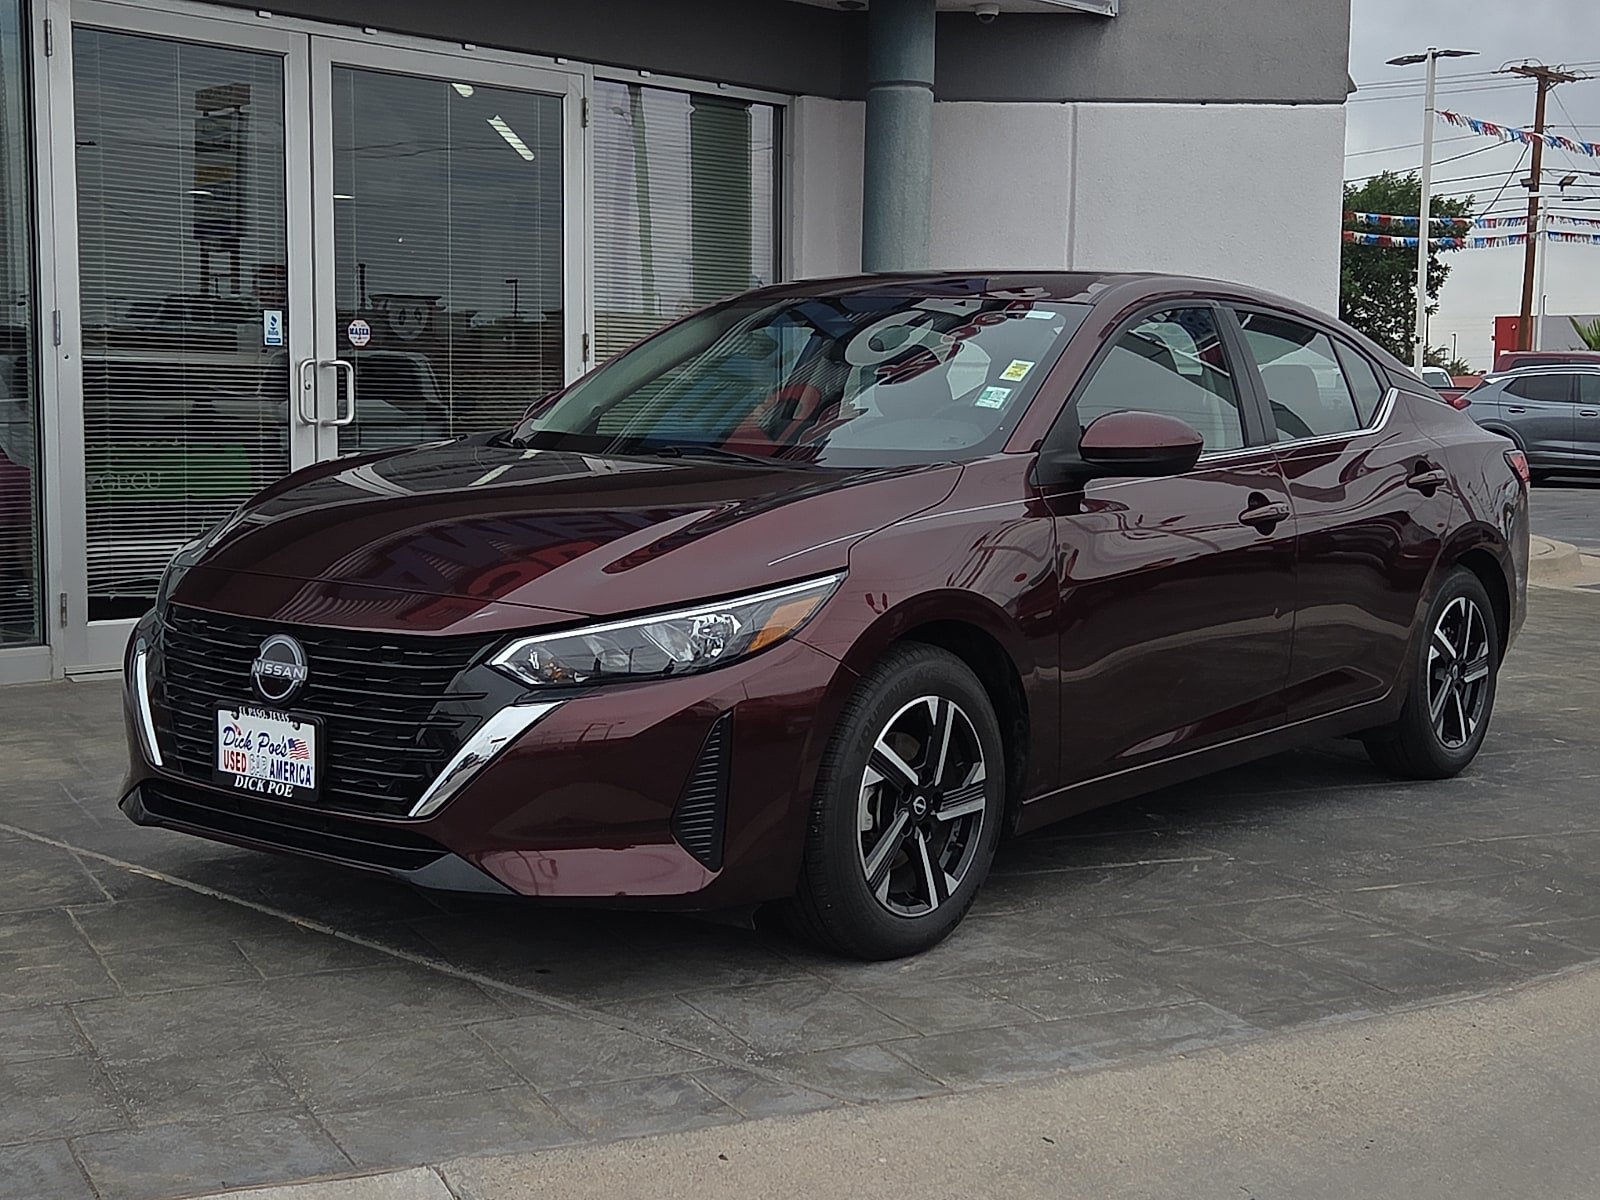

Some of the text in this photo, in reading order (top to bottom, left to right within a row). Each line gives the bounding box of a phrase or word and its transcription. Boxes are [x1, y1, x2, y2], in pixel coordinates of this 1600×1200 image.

[253, 660, 305, 679] NISSAN
[223, 726, 288, 757] Dick Poe's
[223, 749, 247, 772] USED
[269, 758, 313, 787] AMERICA
[234, 775, 294, 798] DICK POE
